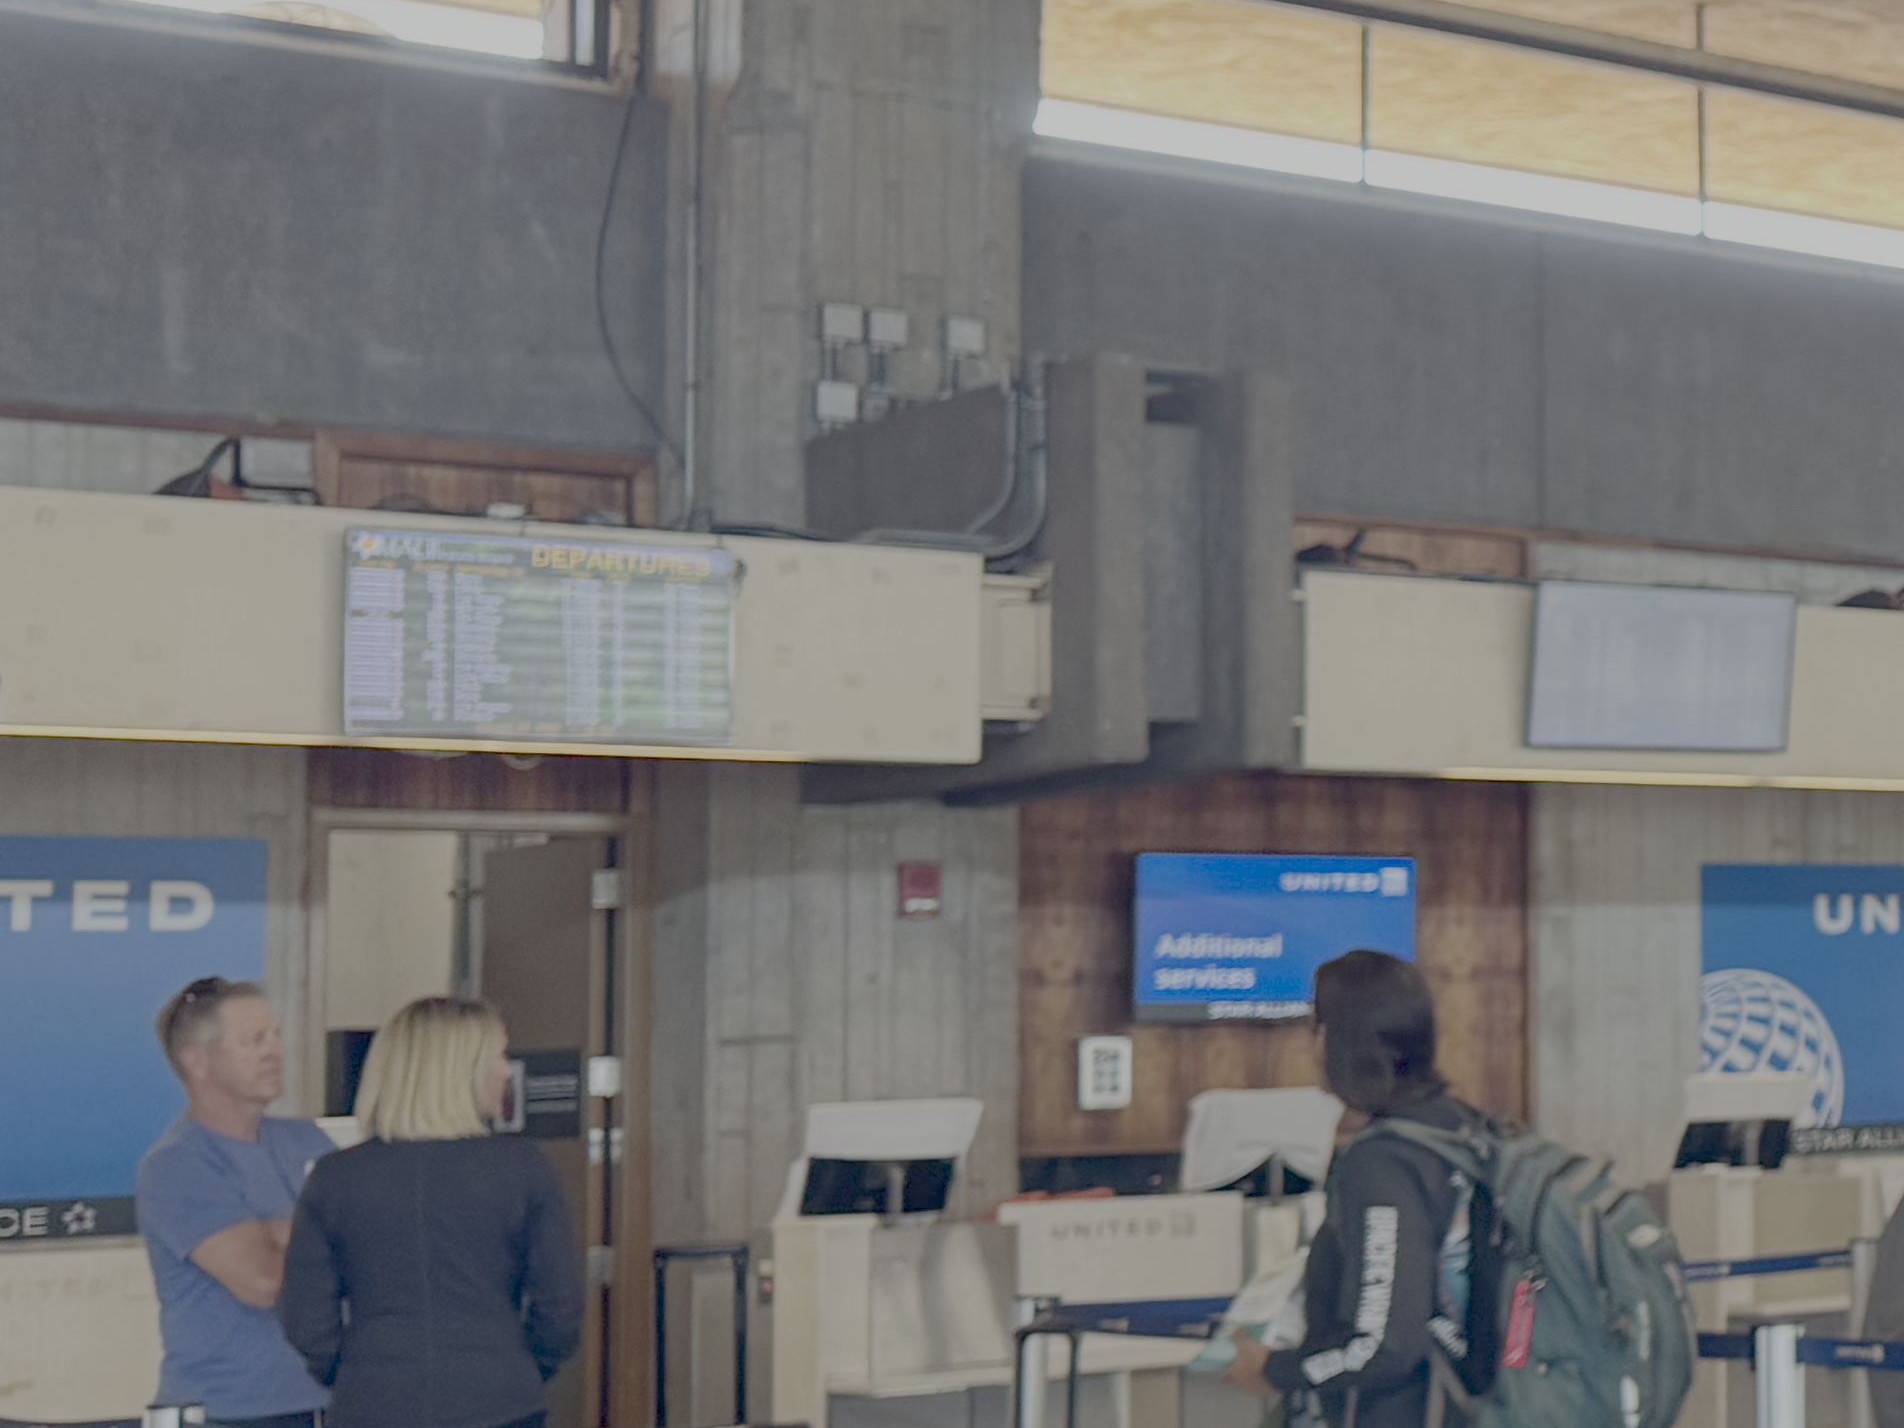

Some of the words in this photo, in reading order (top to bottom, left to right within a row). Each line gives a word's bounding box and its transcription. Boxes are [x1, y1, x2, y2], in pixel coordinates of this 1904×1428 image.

[530, 544, 712, 577] DEPARTURES
[1154, 932, 1283, 959] Additional
[1050, 1216, 1163, 1240] UNITED
